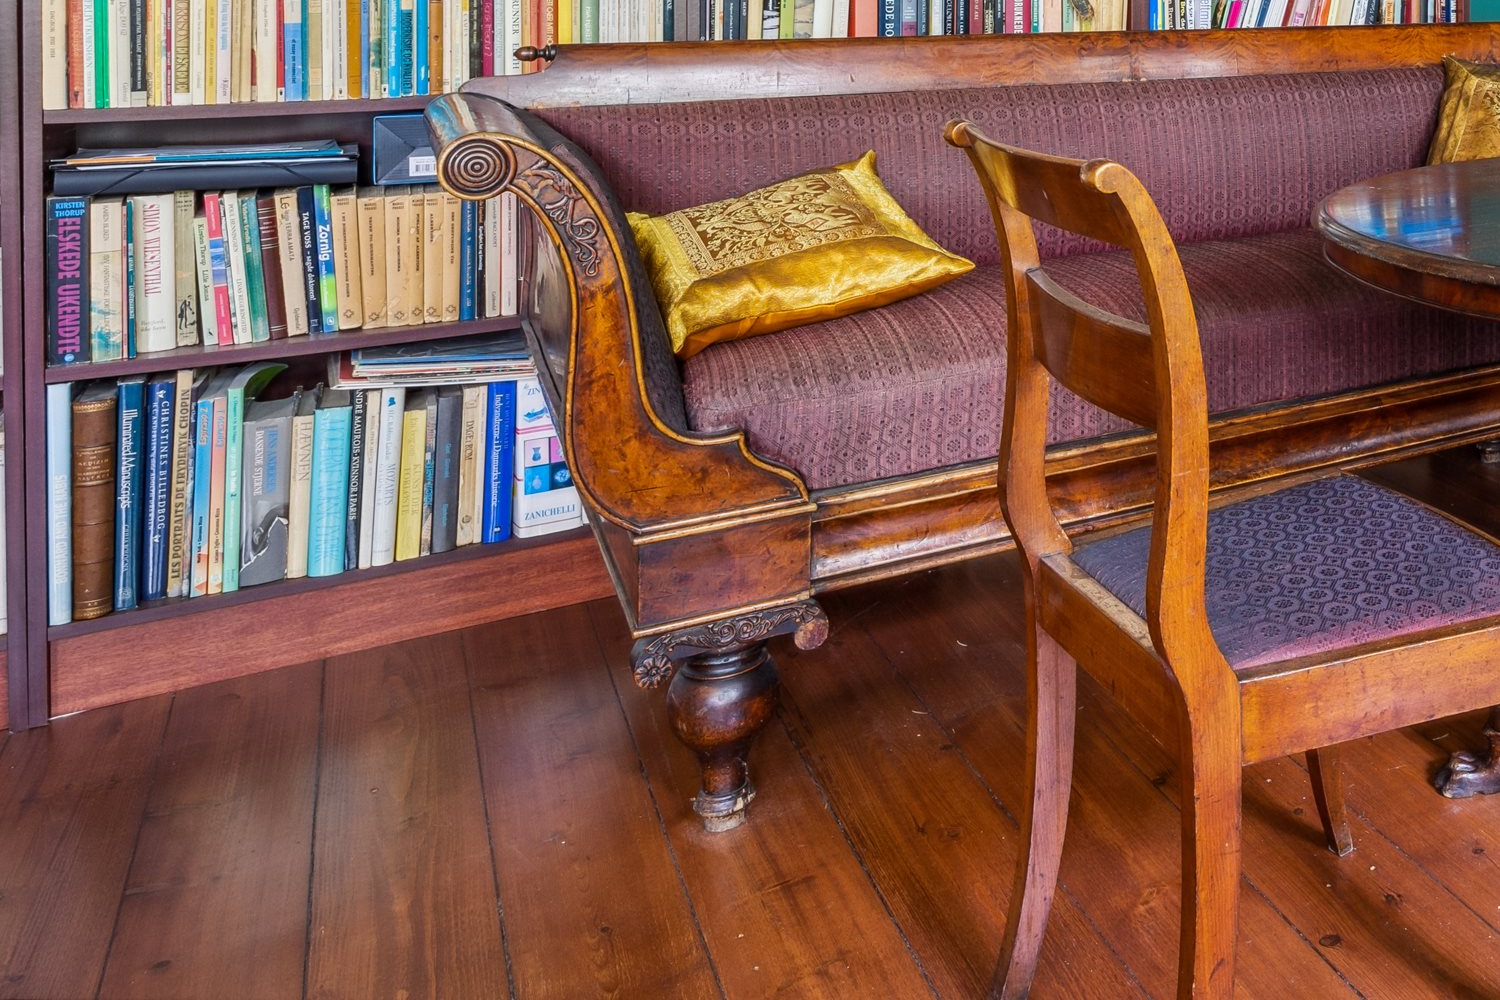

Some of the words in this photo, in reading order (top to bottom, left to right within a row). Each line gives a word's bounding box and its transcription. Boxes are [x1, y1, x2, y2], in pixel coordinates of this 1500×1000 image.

[402, 13, 412, 53] MODERNISME
[175, 46, 188, 91] ELSKEDE
[402, 54, 412, 62] OG
[402, 63, 412, 89] KVALITET
[142, 203, 160, 234] SIMON
[197, 224, 207, 244] Kirsten
[302, 212, 310, 229] TAGE
[57, 218, 80, 279] ELSKEDE
[198, 245, 207, 265] Thorup
[304, 231, 312, 249] VOSS
[317, 225, 333, 261] Zornig
[142, 237, 161, 297] WIESENTHAL
[307, 273, 316, 301] doktoren!
[57, 284, 80, 355] UKENDTE
[179, 389, 190, 429] CHOPIN
[494, 394, 503, 439] Indvandrerne
[122, 409, 138, 456] Illuminated
[159, 401, 169, 465] CHRISTINES
[255, 430, 264, 466] DANSENDE
[352, 416, 361, 453] MAUROIS
[176, 433, 186, 485] FRYDERYK
[298, 422, 313, 482] HÆVNEN
[492, 445, 501, 480] Danmarks
[118, 457, 132, 509] Manuscripts
[253, 468, 263, 496] STJERNE
[350, 456, 359, 492] KVINNOR
[384, 464, 395, 505] MOZARTS
[412, 464, 423, 493] KUNST
[157, 470, 167, 529] BILLEDBOG
[175, 486, 185, 499] DE
[411, 496, 421, 516] DER
[491, 480, 500, 507] historie
[524, 504, 576, 520] ZANICHELLI
[172, 502, 183, 559] PORTRAITS
[171, 561, 181, 579] LES
